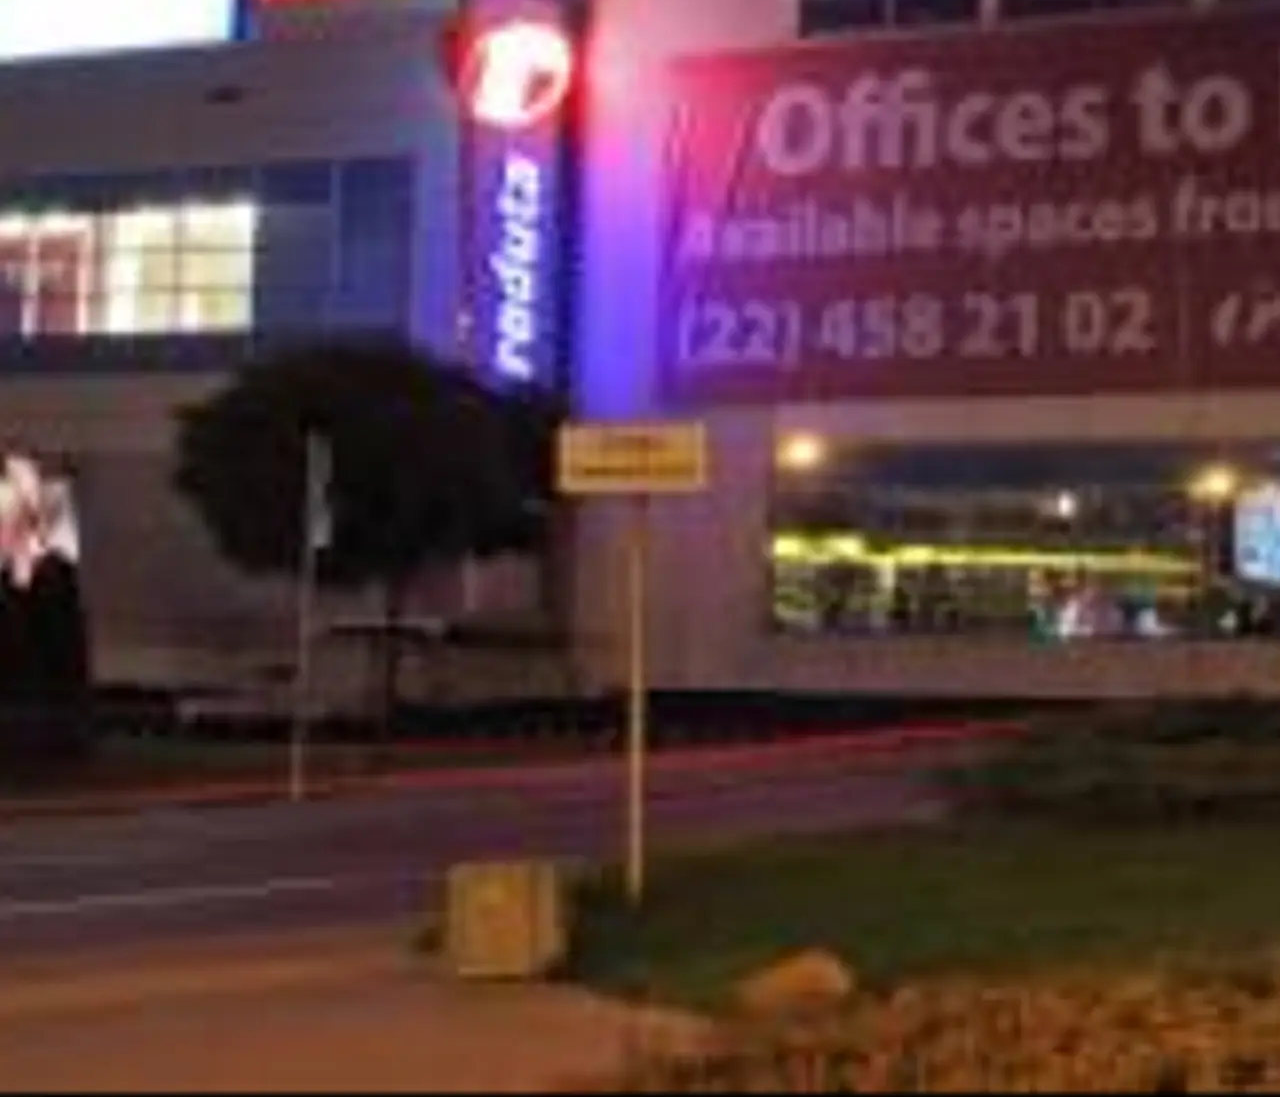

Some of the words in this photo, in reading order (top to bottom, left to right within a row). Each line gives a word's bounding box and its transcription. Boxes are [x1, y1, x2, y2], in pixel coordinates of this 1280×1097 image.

[758, 68, 1108, 174] Offices
[1132, 62, 1252, 154] to
[491, 156, 540, 380] reduta
[678, 298, 798, 368] (22)
[820, 294, 944, 360] 458
[960, 292, 1038, 358] 21
[1064, 288, 1158, 354] 02
